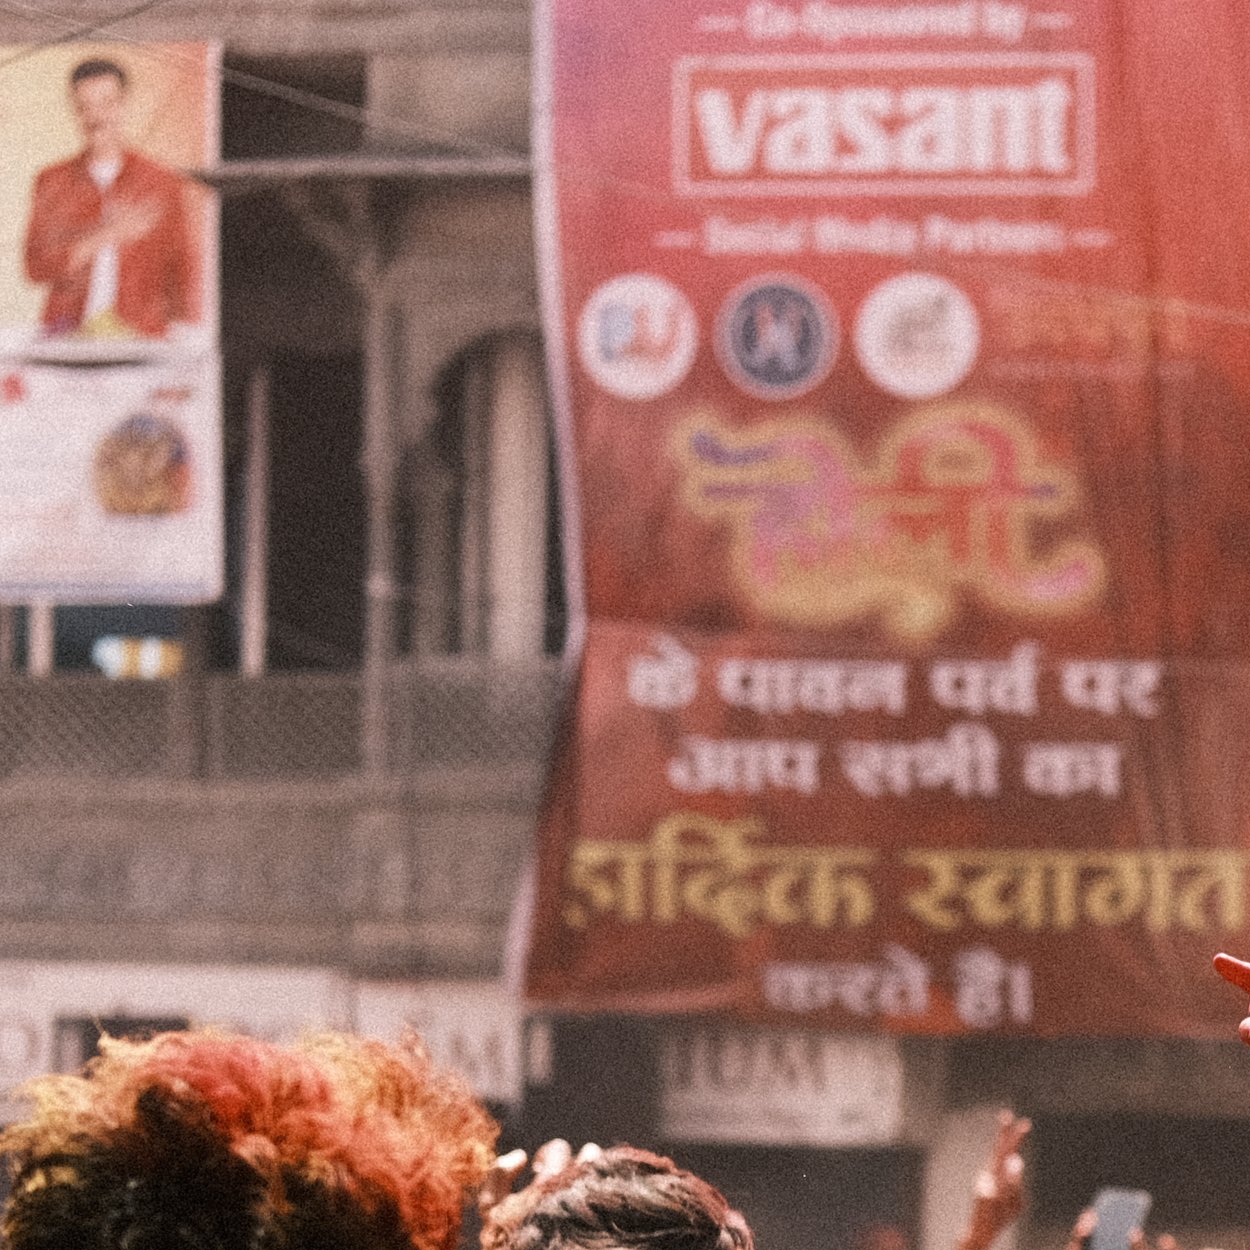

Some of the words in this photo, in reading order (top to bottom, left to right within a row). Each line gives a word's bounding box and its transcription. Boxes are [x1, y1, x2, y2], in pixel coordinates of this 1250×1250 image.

[695, 80, 1069, 173] vasant
[627, 637, 697, 709] के
[716, 657, 906, 713] पावन
[932, 642, 1038, 715] पर्व
[1062, 659, 1161, 717] पर
[668, 738, 818, 792] आप
[842, 725, 999, 795] सभी
[1023, 743, 1120, 795] का
[905, 846, 1248, 932] स्वागत
[763, 946, 928, 1013] करते
